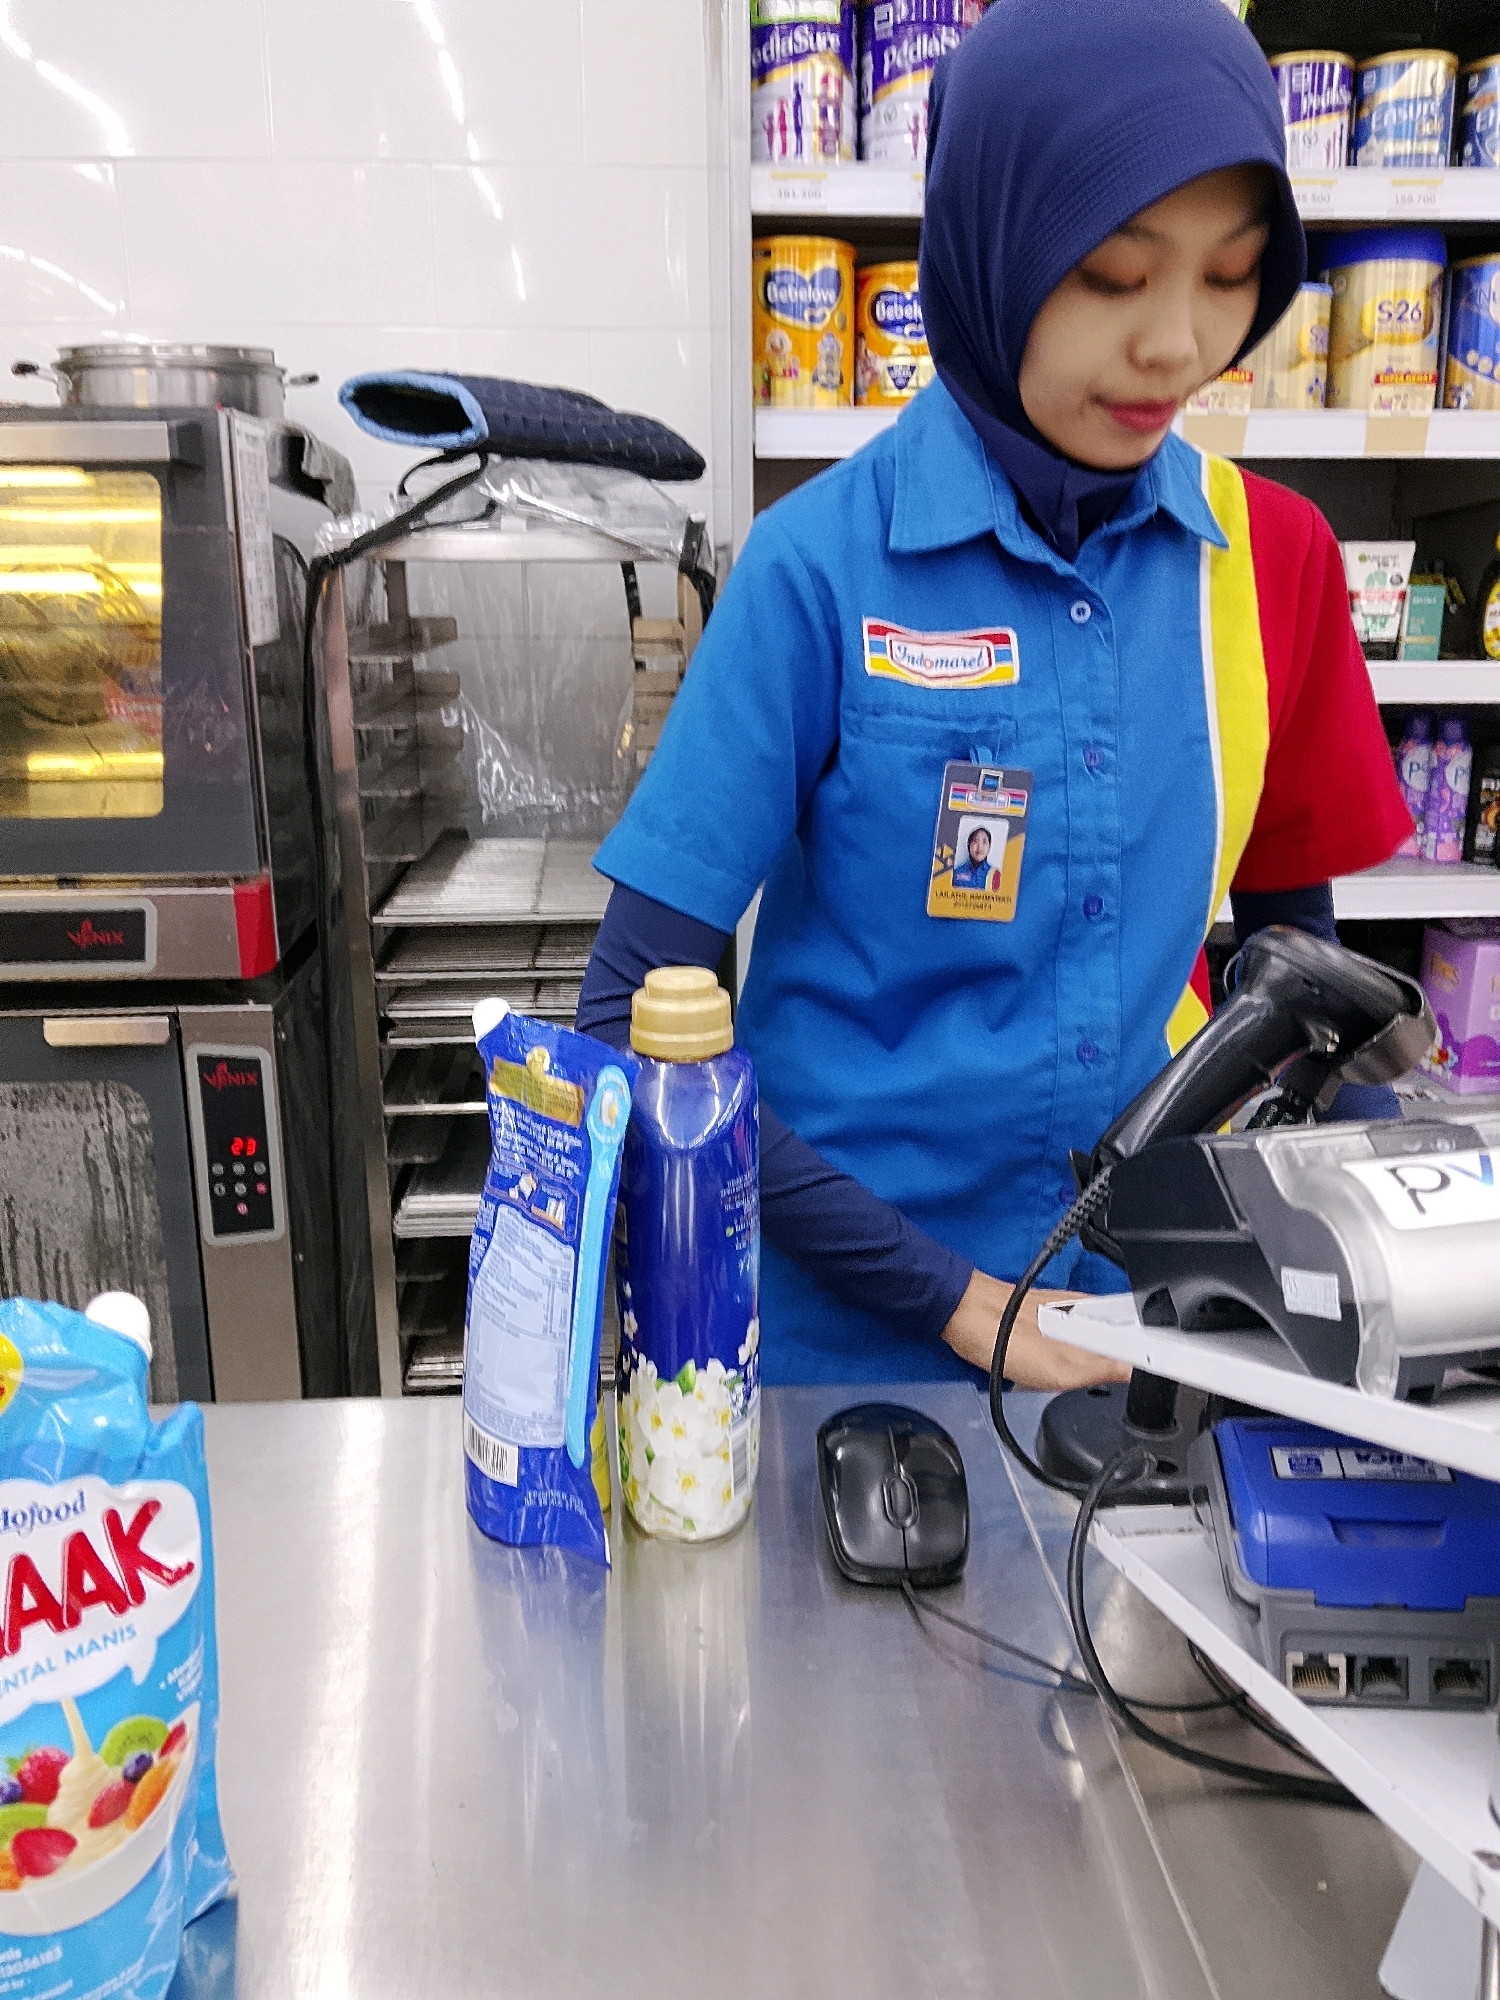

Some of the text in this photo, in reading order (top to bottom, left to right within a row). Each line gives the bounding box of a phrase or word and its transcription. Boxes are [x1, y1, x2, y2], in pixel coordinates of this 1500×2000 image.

[895, 645, 984, 671] Indomaret
[0, 1500, 195, 1661] AAK
[0, 1623, 138, 1696] NTAL MANIS
